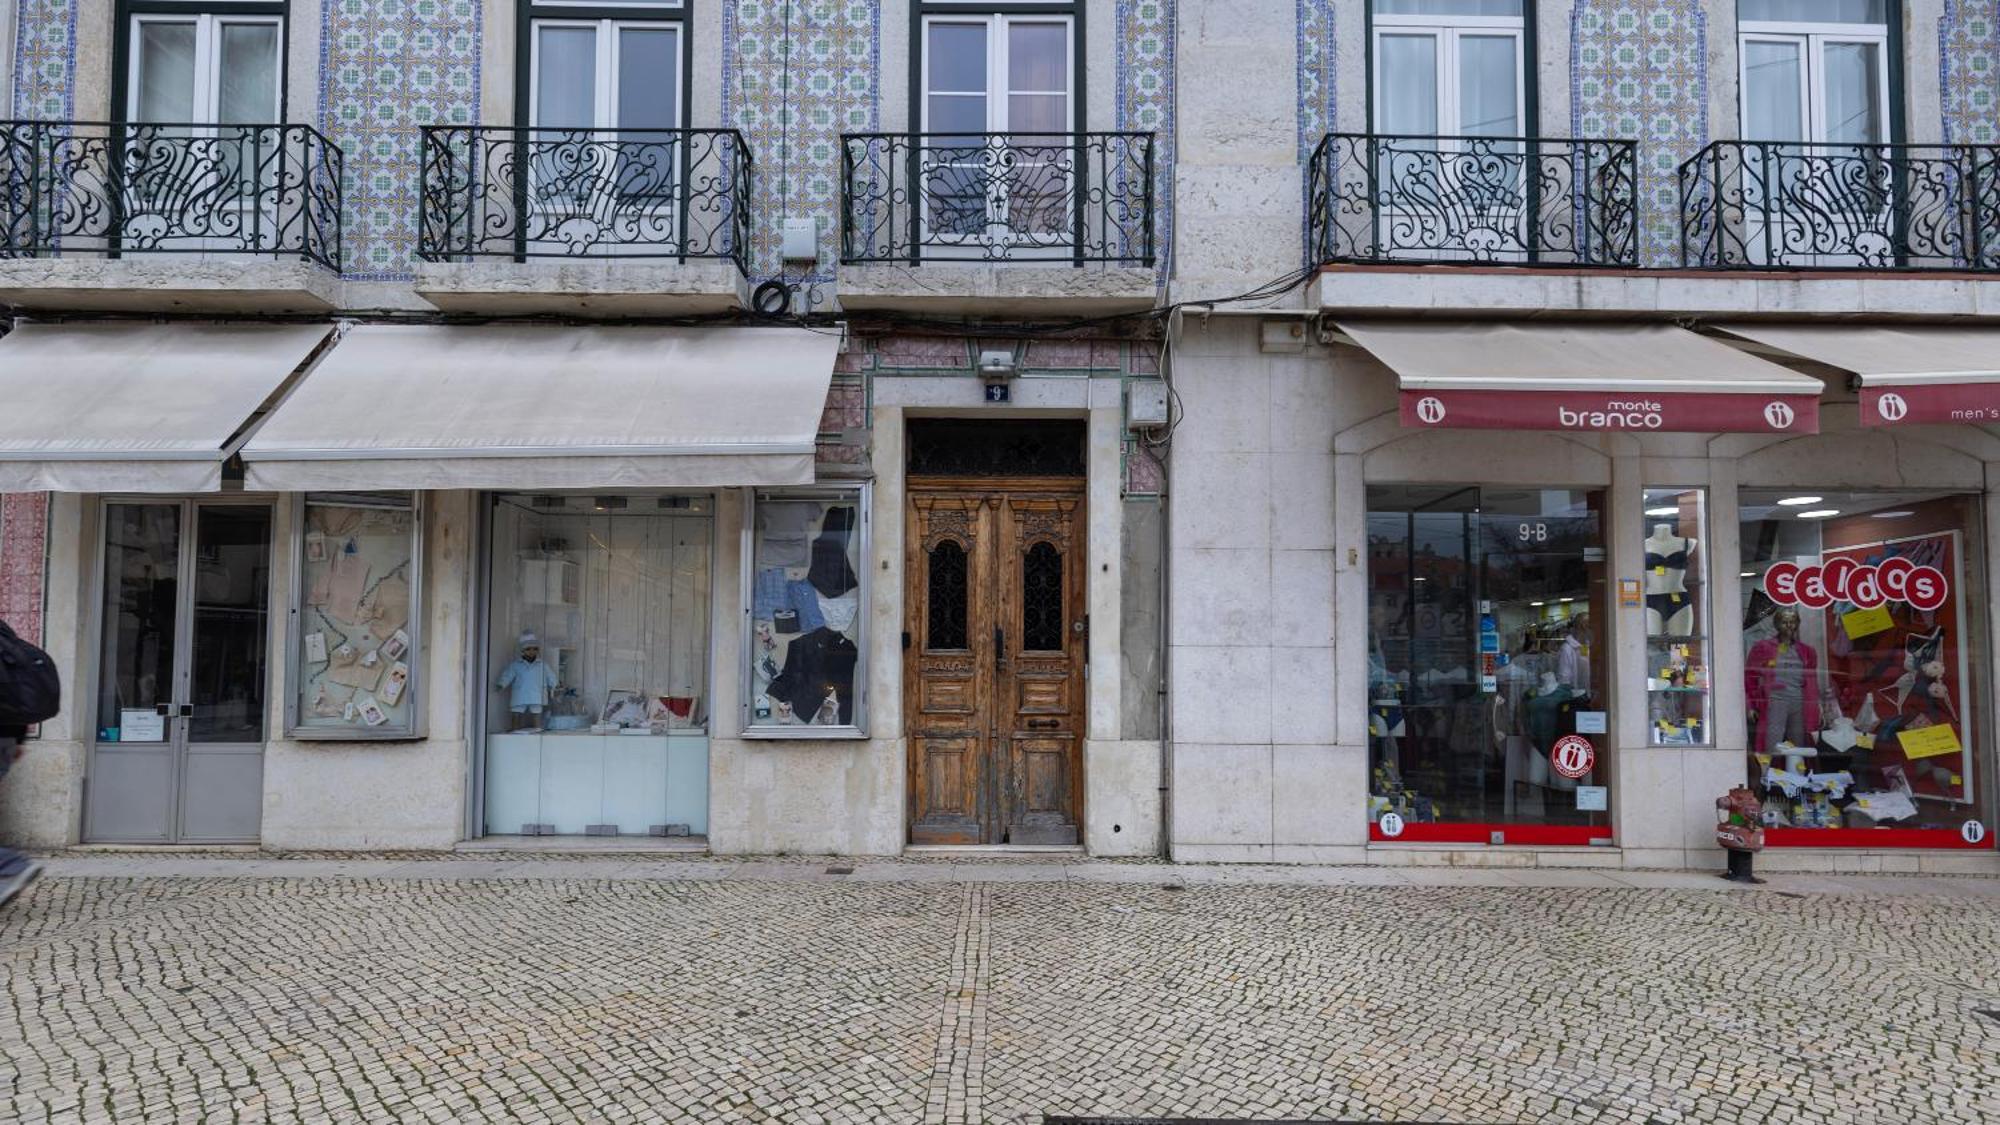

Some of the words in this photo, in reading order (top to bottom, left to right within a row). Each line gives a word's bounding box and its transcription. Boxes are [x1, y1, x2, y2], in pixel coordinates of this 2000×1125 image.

[993, 385, 1001, 400] 9
[1607, 400, 1662, 411] monte
[1951, 407, 1999, 419] men's
[1559, 406, 1662, 428] branco
[1519, 523, 1547, 541] 9-B
[1775, 566, 1936, 602] saldos
